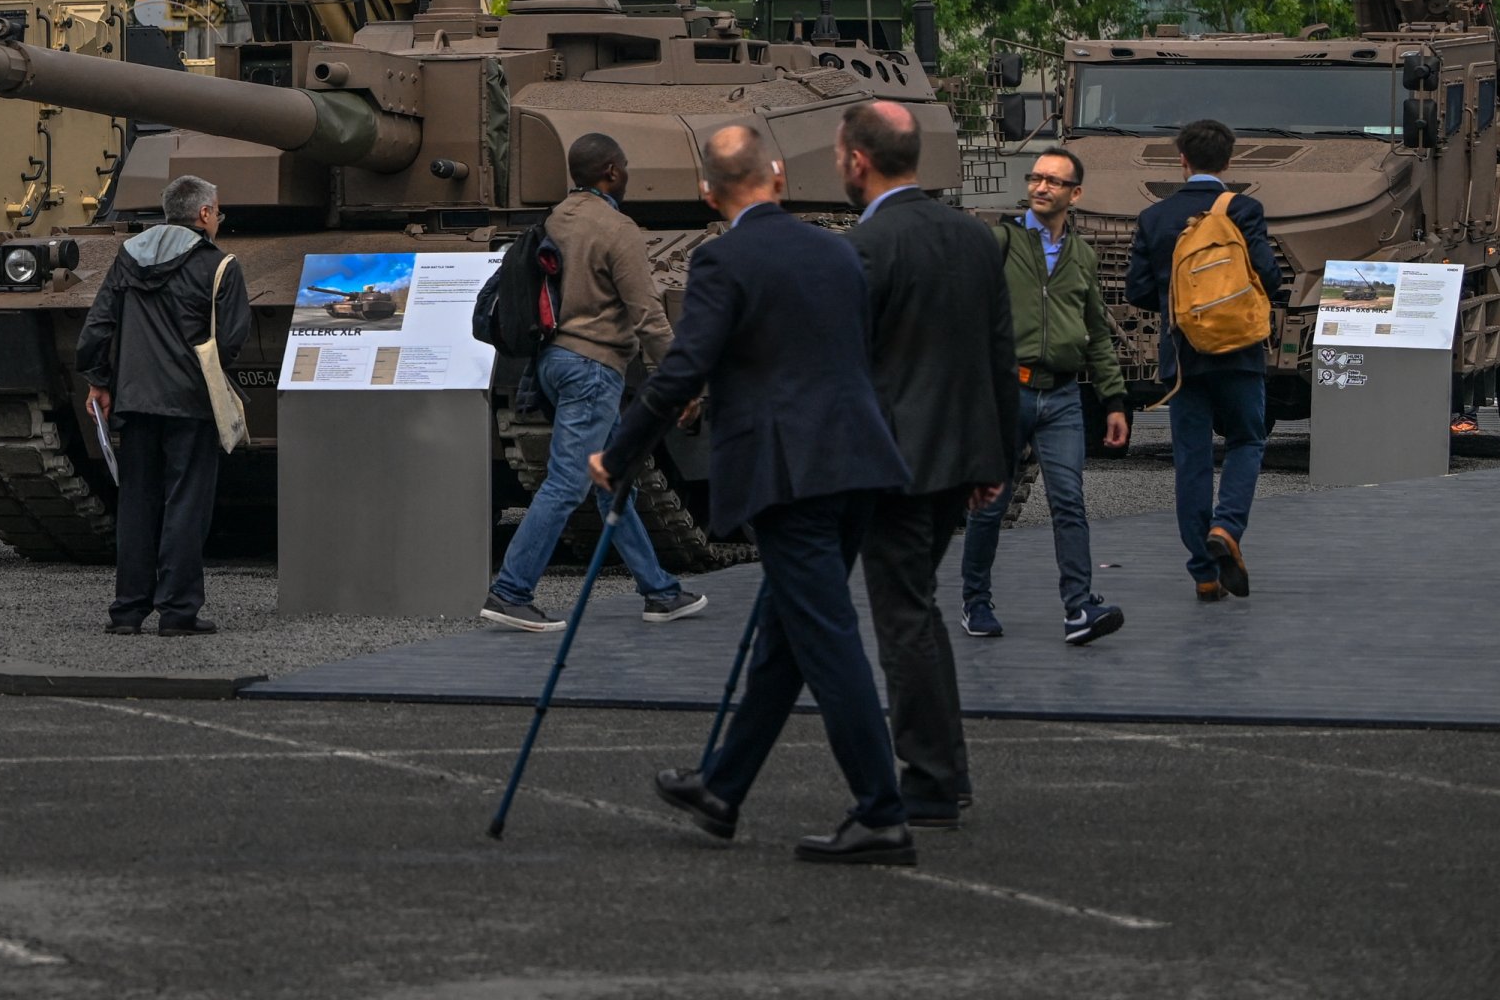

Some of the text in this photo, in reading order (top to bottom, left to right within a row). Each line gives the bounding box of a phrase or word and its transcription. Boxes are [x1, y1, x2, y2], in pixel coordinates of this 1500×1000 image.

[291, 327, 362, 336] LECLERC XLR
[238, 371, 276, 386] 6054
